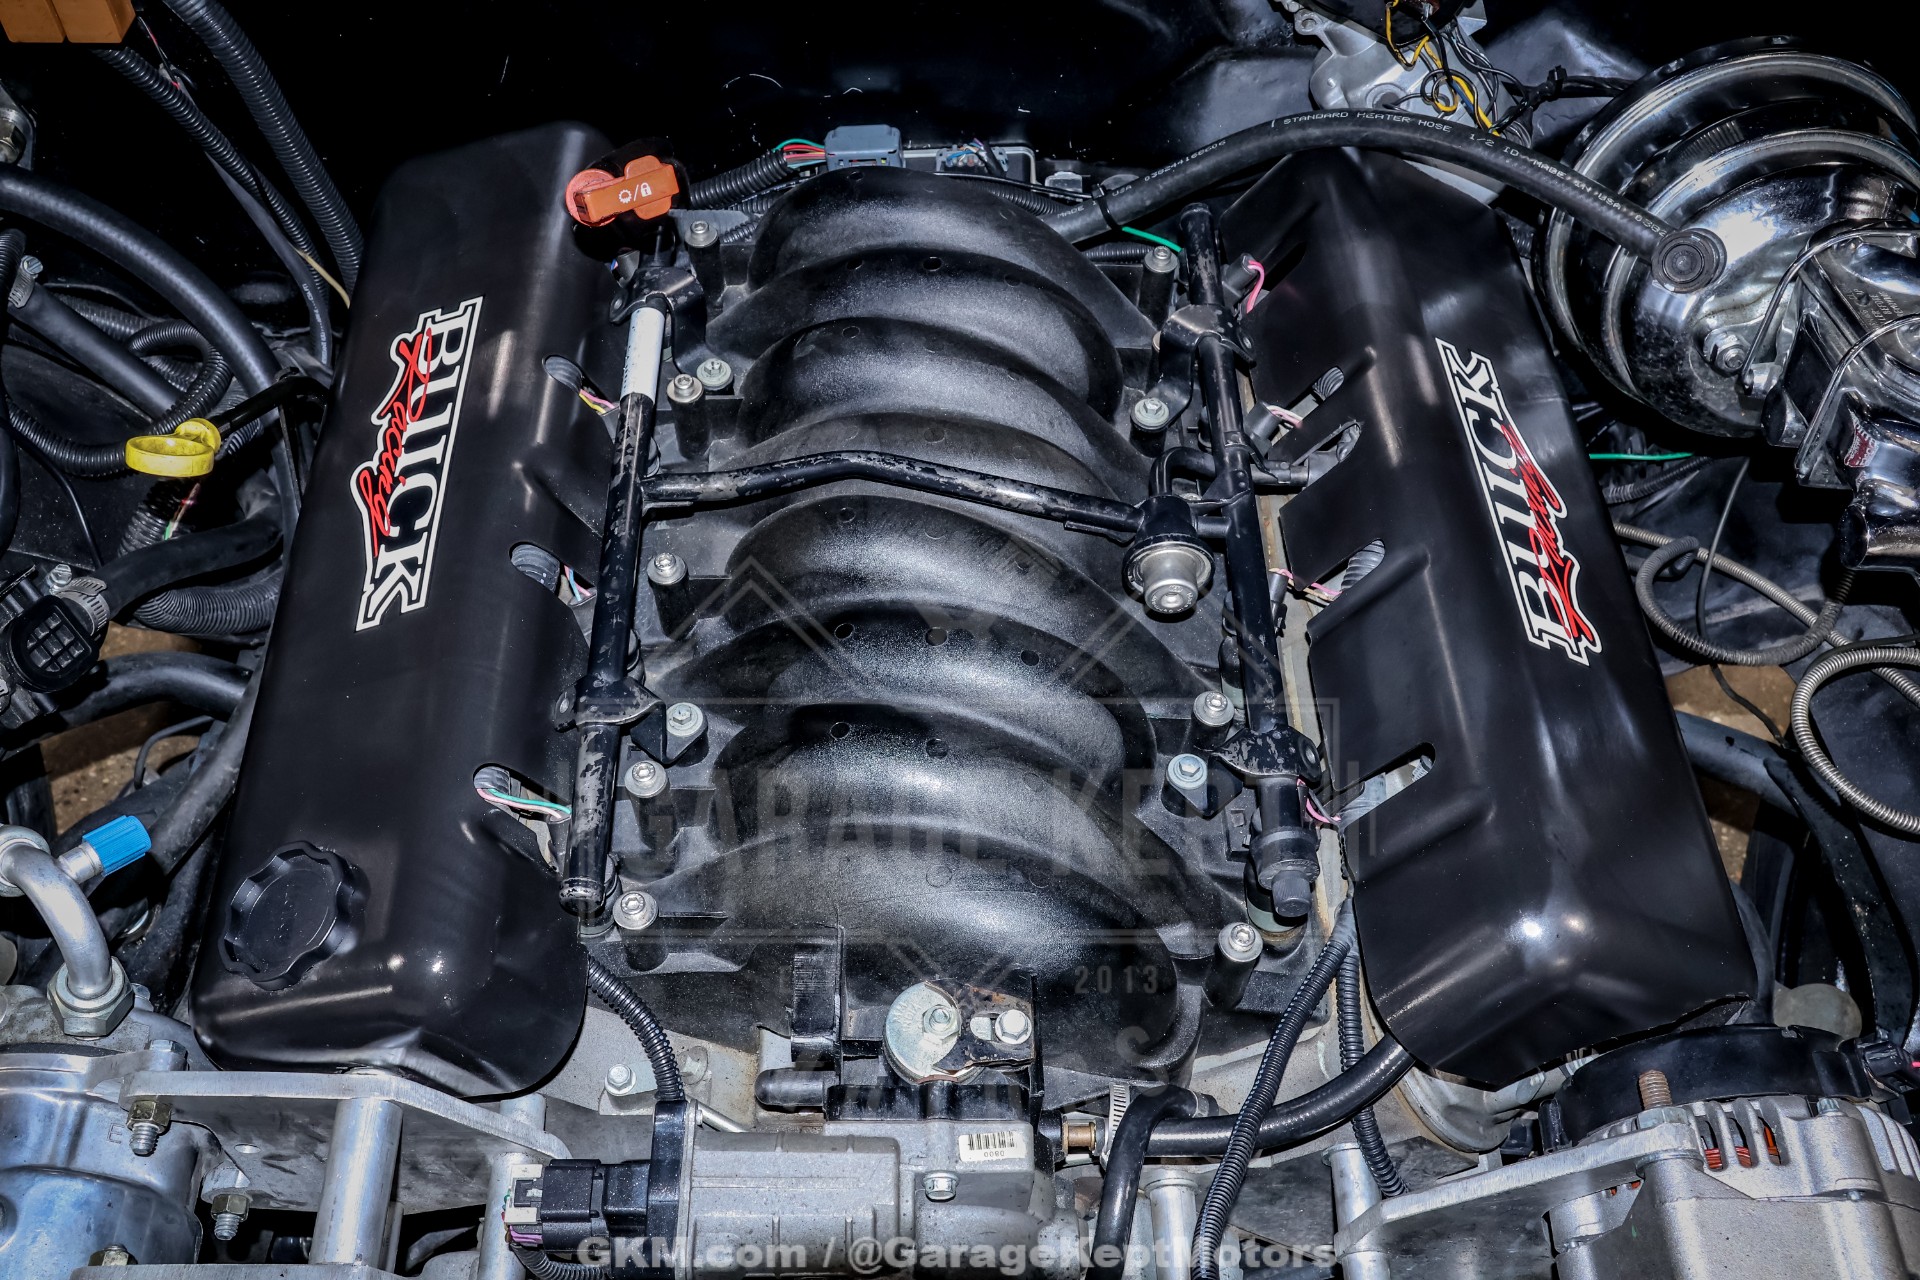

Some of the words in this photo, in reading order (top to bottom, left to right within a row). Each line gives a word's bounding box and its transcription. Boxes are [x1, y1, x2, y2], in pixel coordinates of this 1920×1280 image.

[1112, 185, 1132, 197] USA
[1283, 112, 1349, 125] STANDARD
[1357, 111, 1411, 124] HEATER
[1418, 119, 1452, 132] HOSE
[1469, 133, 1495, 147] 1/2
[359, 326, 433, 558] Racing
[366, 304, 473, 620] BUICK
[1444, 347, 1578, 654] BUICK
